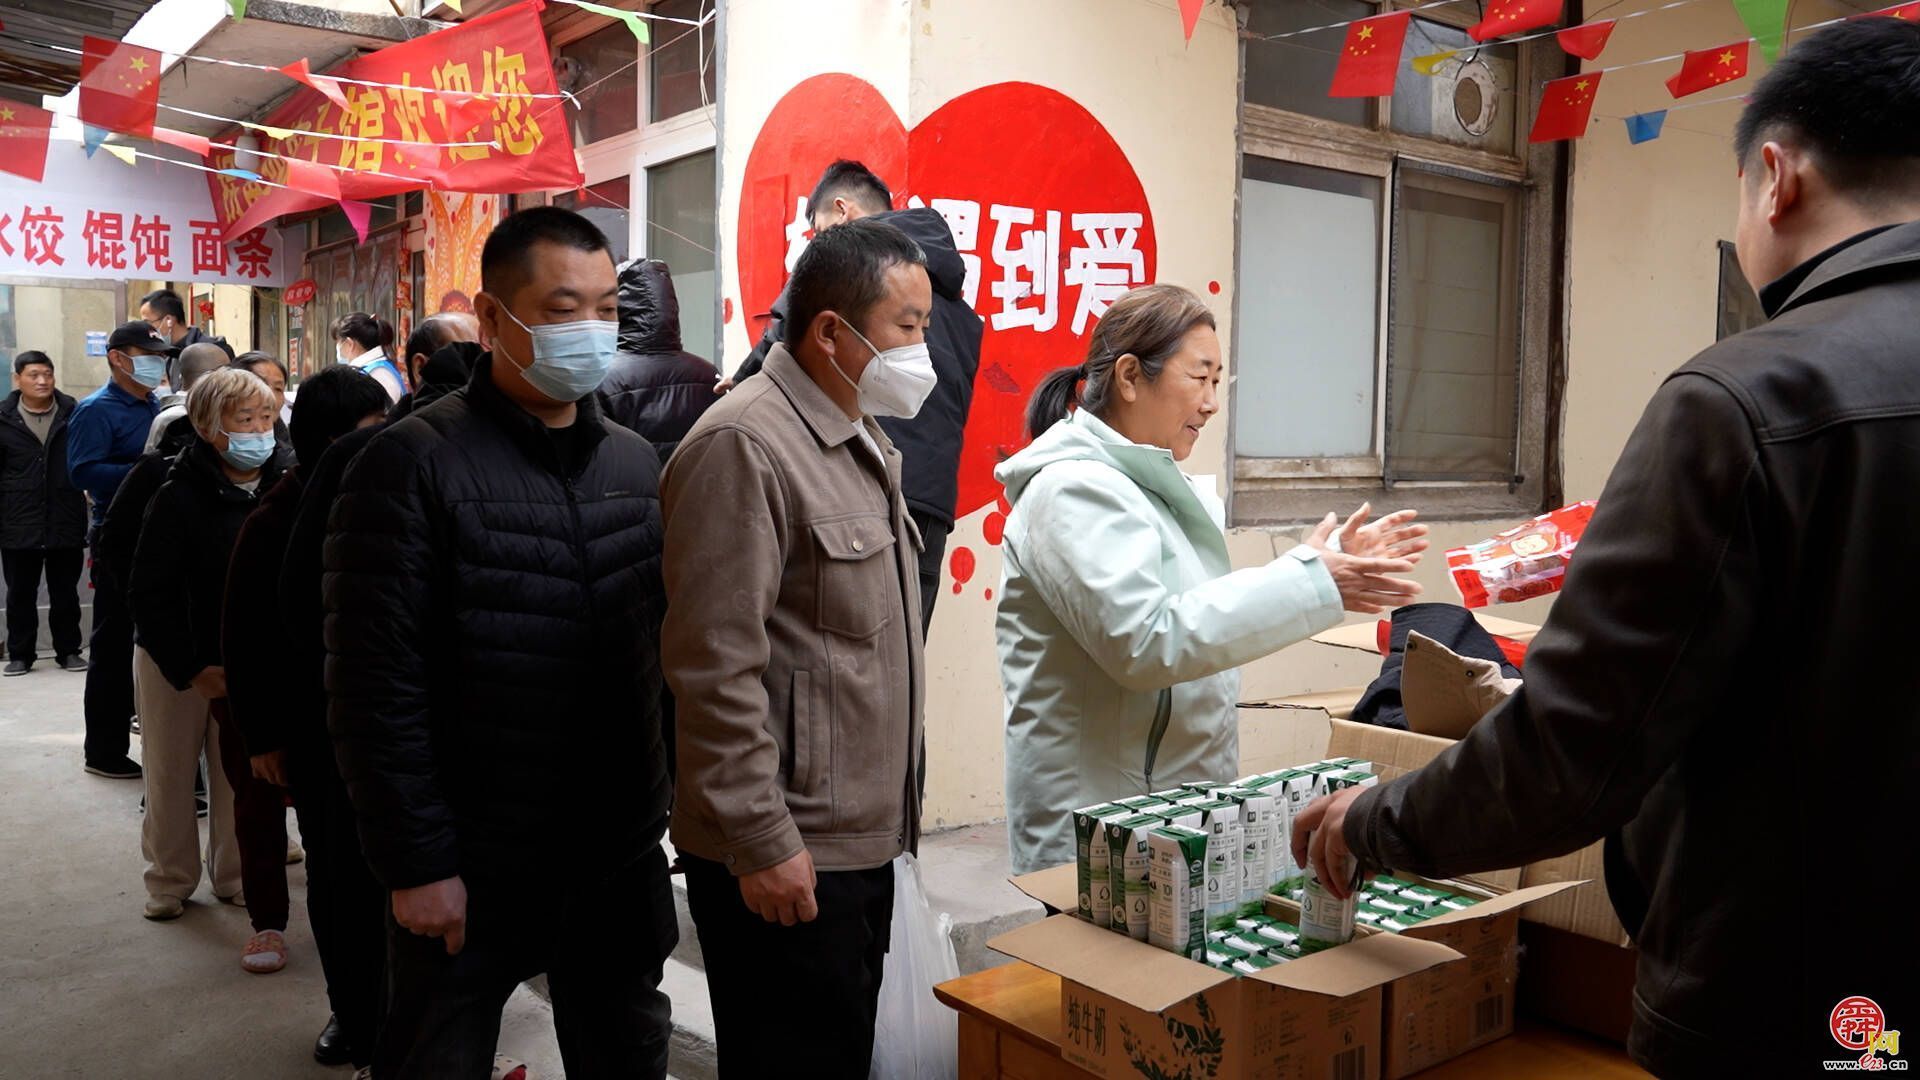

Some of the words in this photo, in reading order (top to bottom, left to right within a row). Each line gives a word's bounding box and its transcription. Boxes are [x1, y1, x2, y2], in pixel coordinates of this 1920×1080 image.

[82, 209, 173, 273] 馄饨
[188, 219, 274, 279] 面条
[1067, 994, 1107, 1057] 纯牛奶
